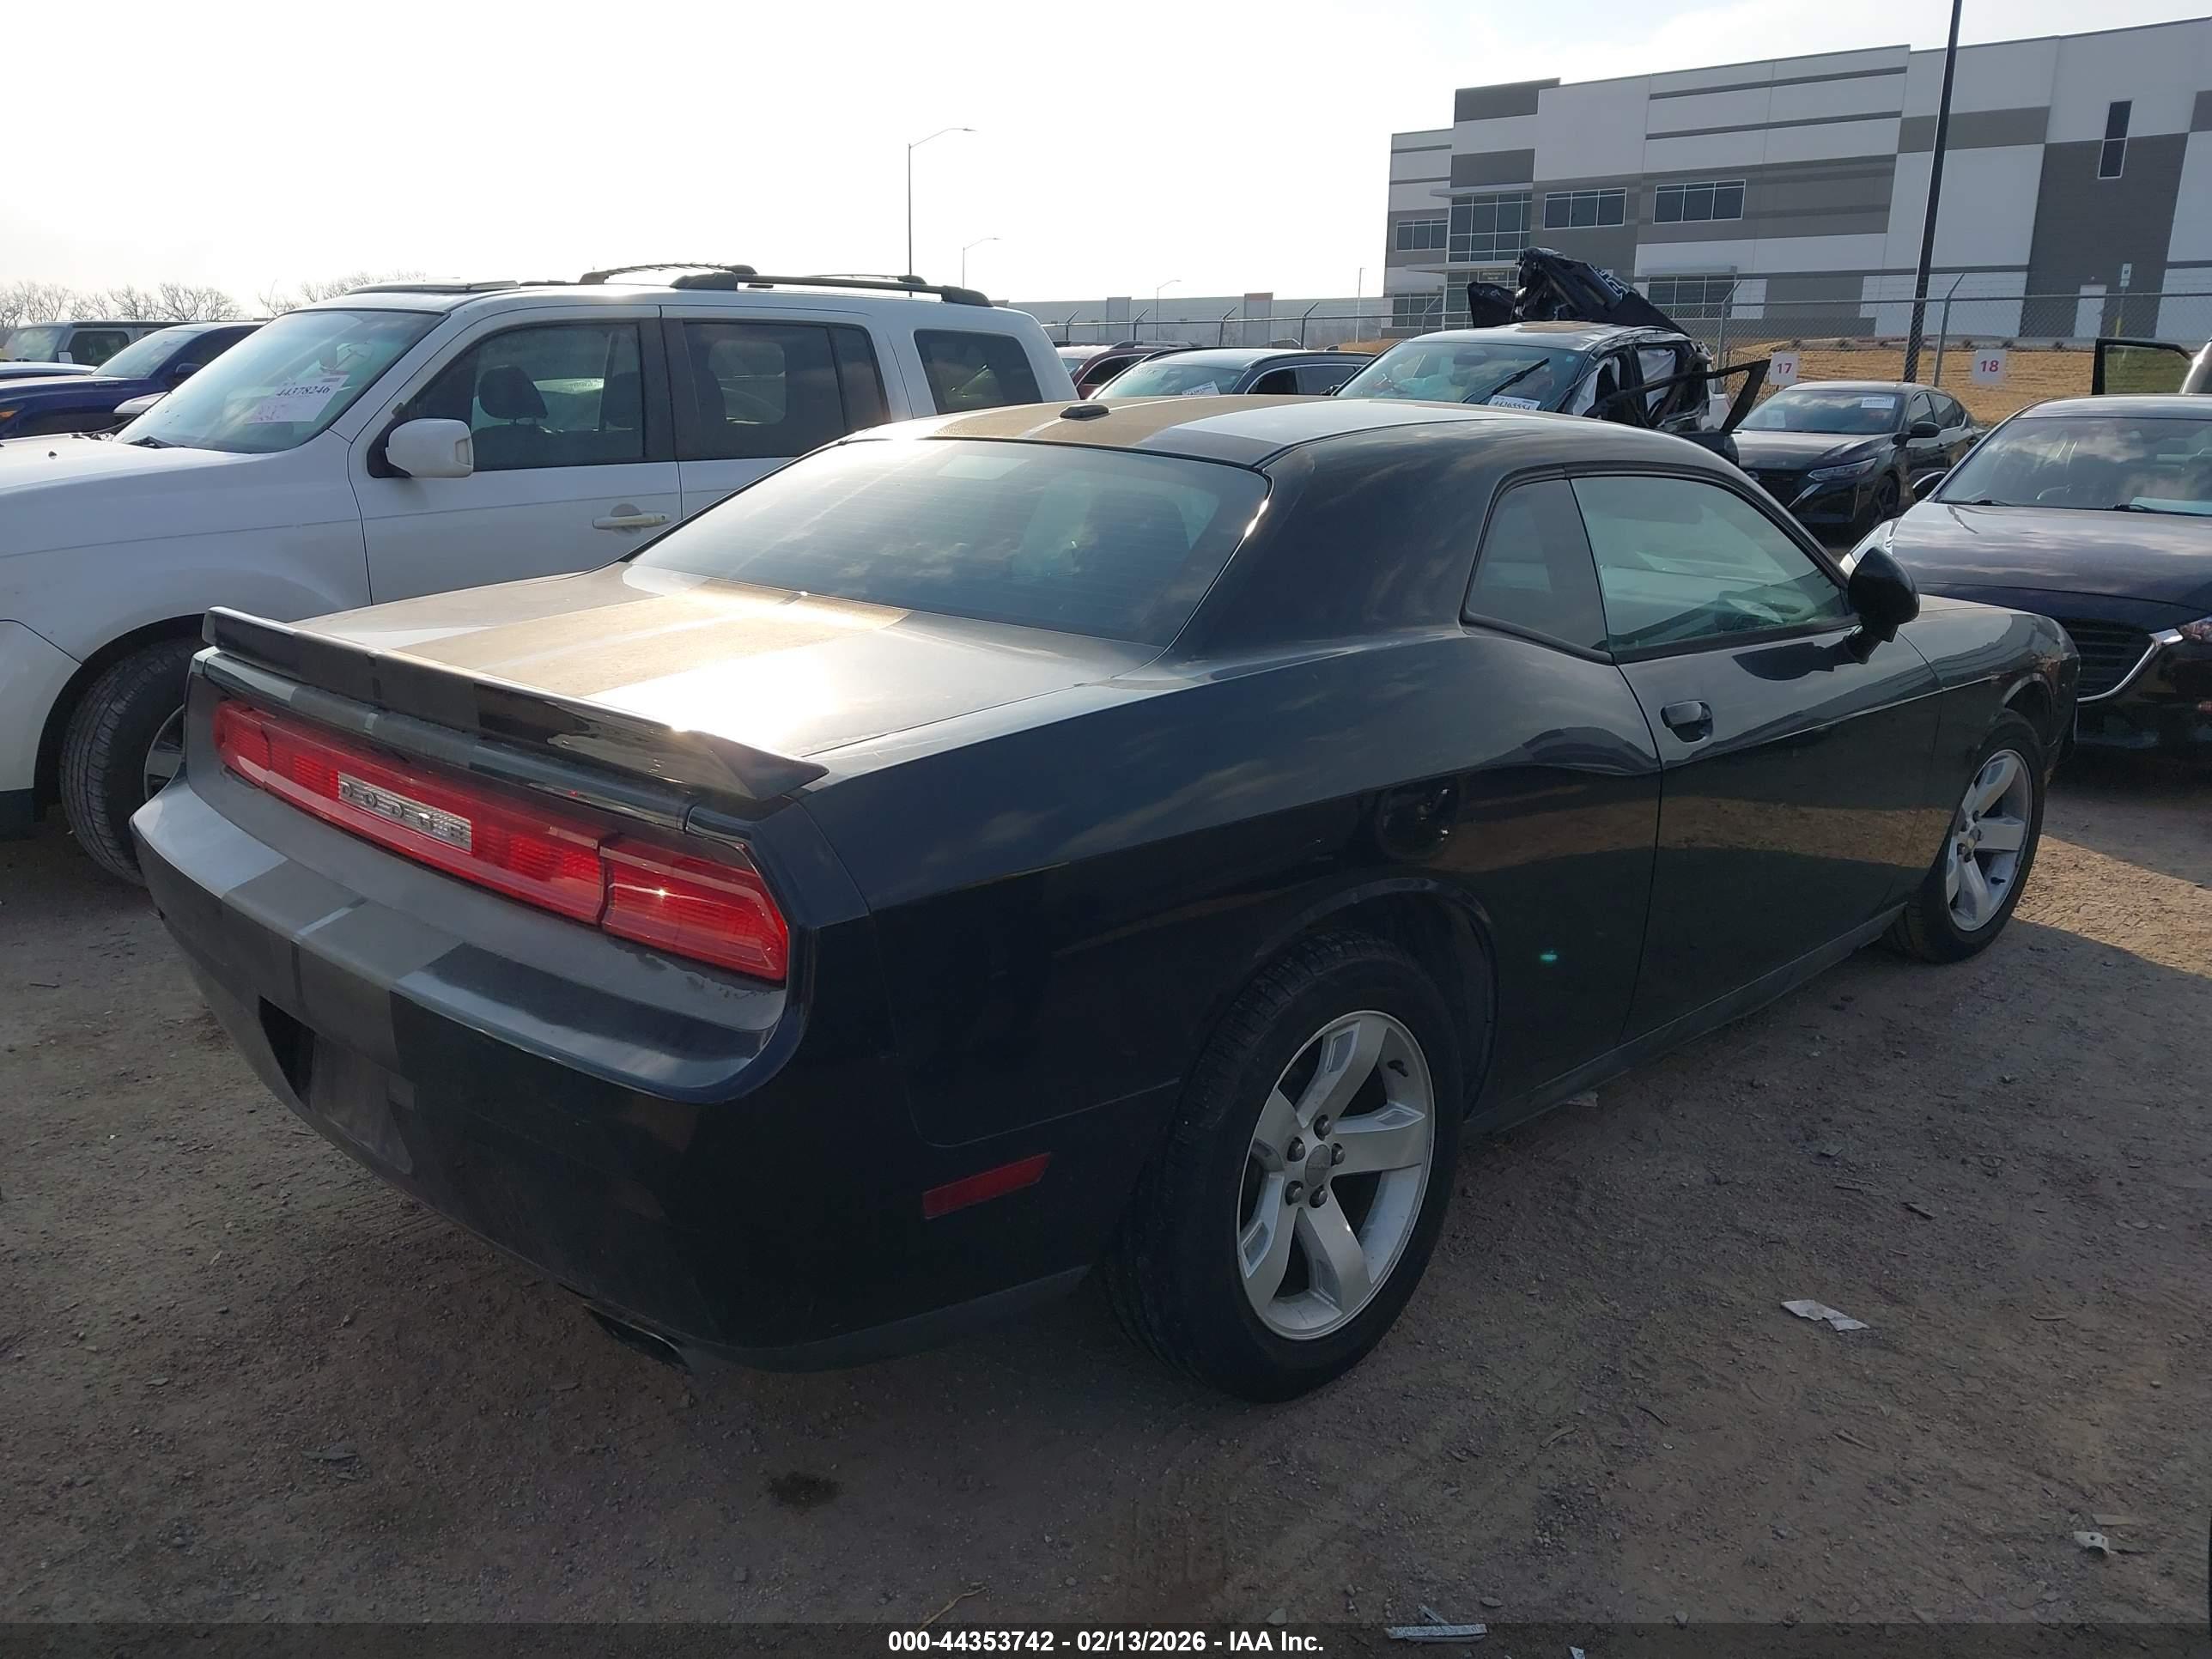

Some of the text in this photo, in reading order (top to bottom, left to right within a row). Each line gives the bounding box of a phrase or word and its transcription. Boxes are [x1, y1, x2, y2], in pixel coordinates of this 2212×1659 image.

[1777, 362, 1793, 374] 17
[1980, 360, 1999, 373] 18
[276, 385, 331, 397] 44378246
[338, 780, 469, 842] DODGE
